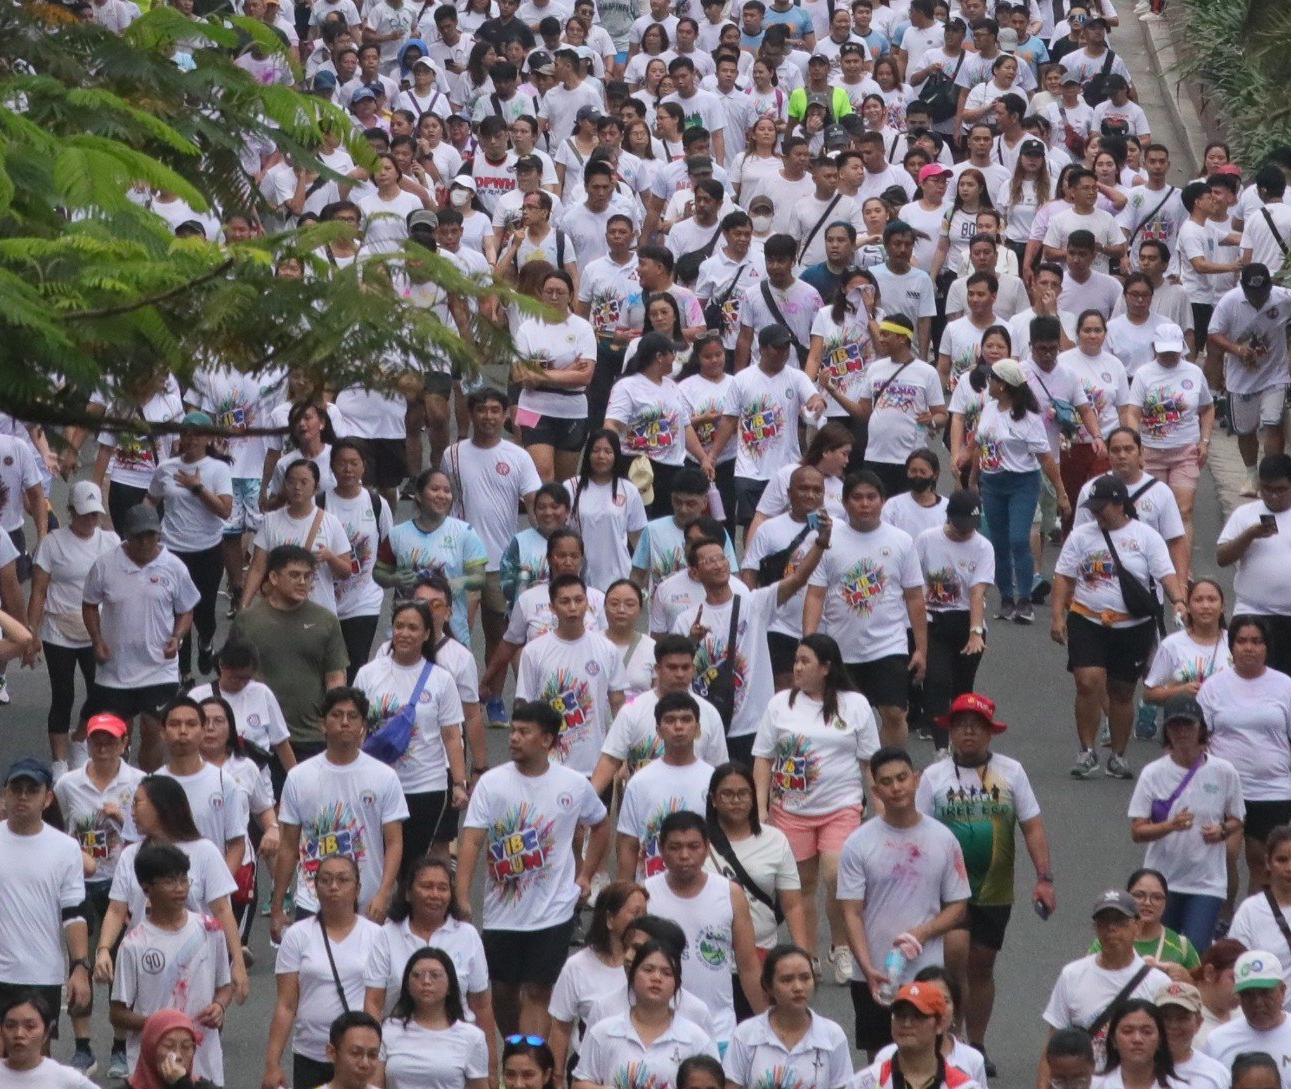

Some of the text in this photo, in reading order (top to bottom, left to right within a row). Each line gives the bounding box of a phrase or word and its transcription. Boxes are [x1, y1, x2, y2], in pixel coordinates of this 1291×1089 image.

[961, 222, 976, 239] 80
[306, 832, 352, 858] VIBE
[491, 829, 540, 861] VIBE
[494, 849, 545, 882] RUN
[145, 953, 161, 970] 90
